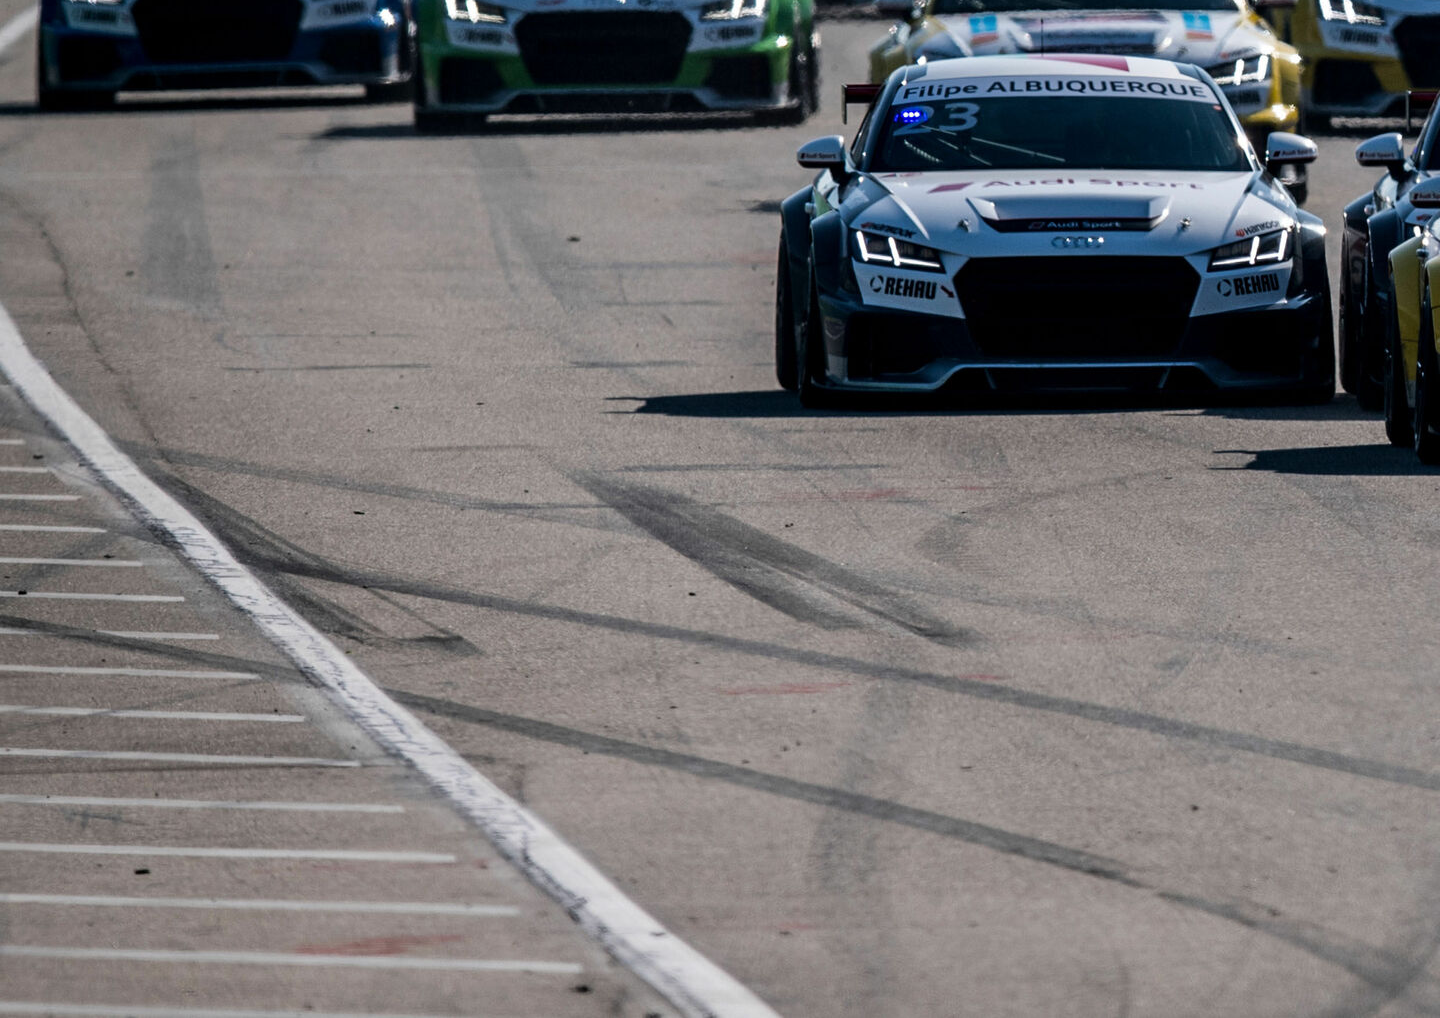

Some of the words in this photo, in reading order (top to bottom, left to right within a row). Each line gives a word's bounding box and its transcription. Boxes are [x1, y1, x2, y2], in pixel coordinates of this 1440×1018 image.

[902, 80, 979, 99] Filipe
[985, 78, 1208, 99] ALBUQUERQUE
[893, 102, 981, 137] 23
[982, 178, 1075, 188] Audi
[1089, 177, 1206, 190] Sport
[1046, 219, 1079, 229] Audi
[1081, 219, 1123, 231] Sport
[884, 276, 938, 300] REHAU
[1233, 273, 1280, 296] REHAU
